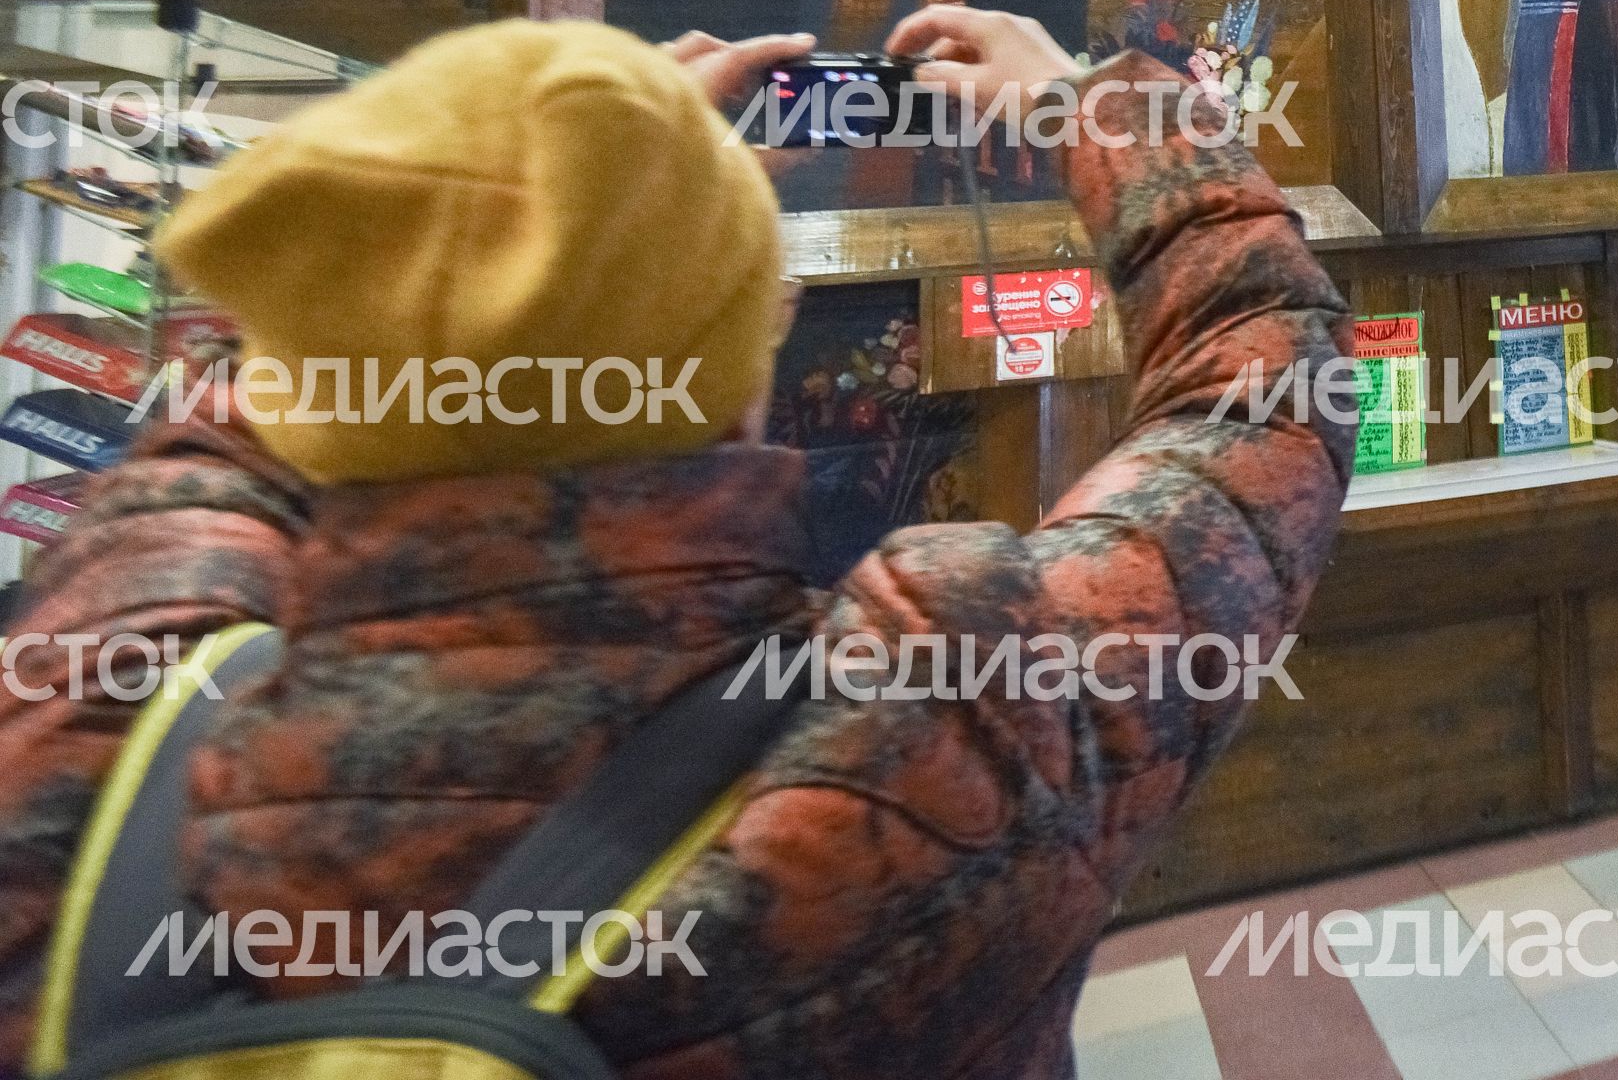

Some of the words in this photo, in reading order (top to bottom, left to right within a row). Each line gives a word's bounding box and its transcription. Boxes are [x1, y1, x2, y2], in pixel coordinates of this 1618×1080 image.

[1501, 302, 1583, 326] МЕНЮ
[13, 328, 110, 374] HALLS
[7, 408, 105, 455] HALLS
[3, 499, 72, 533] HAL
